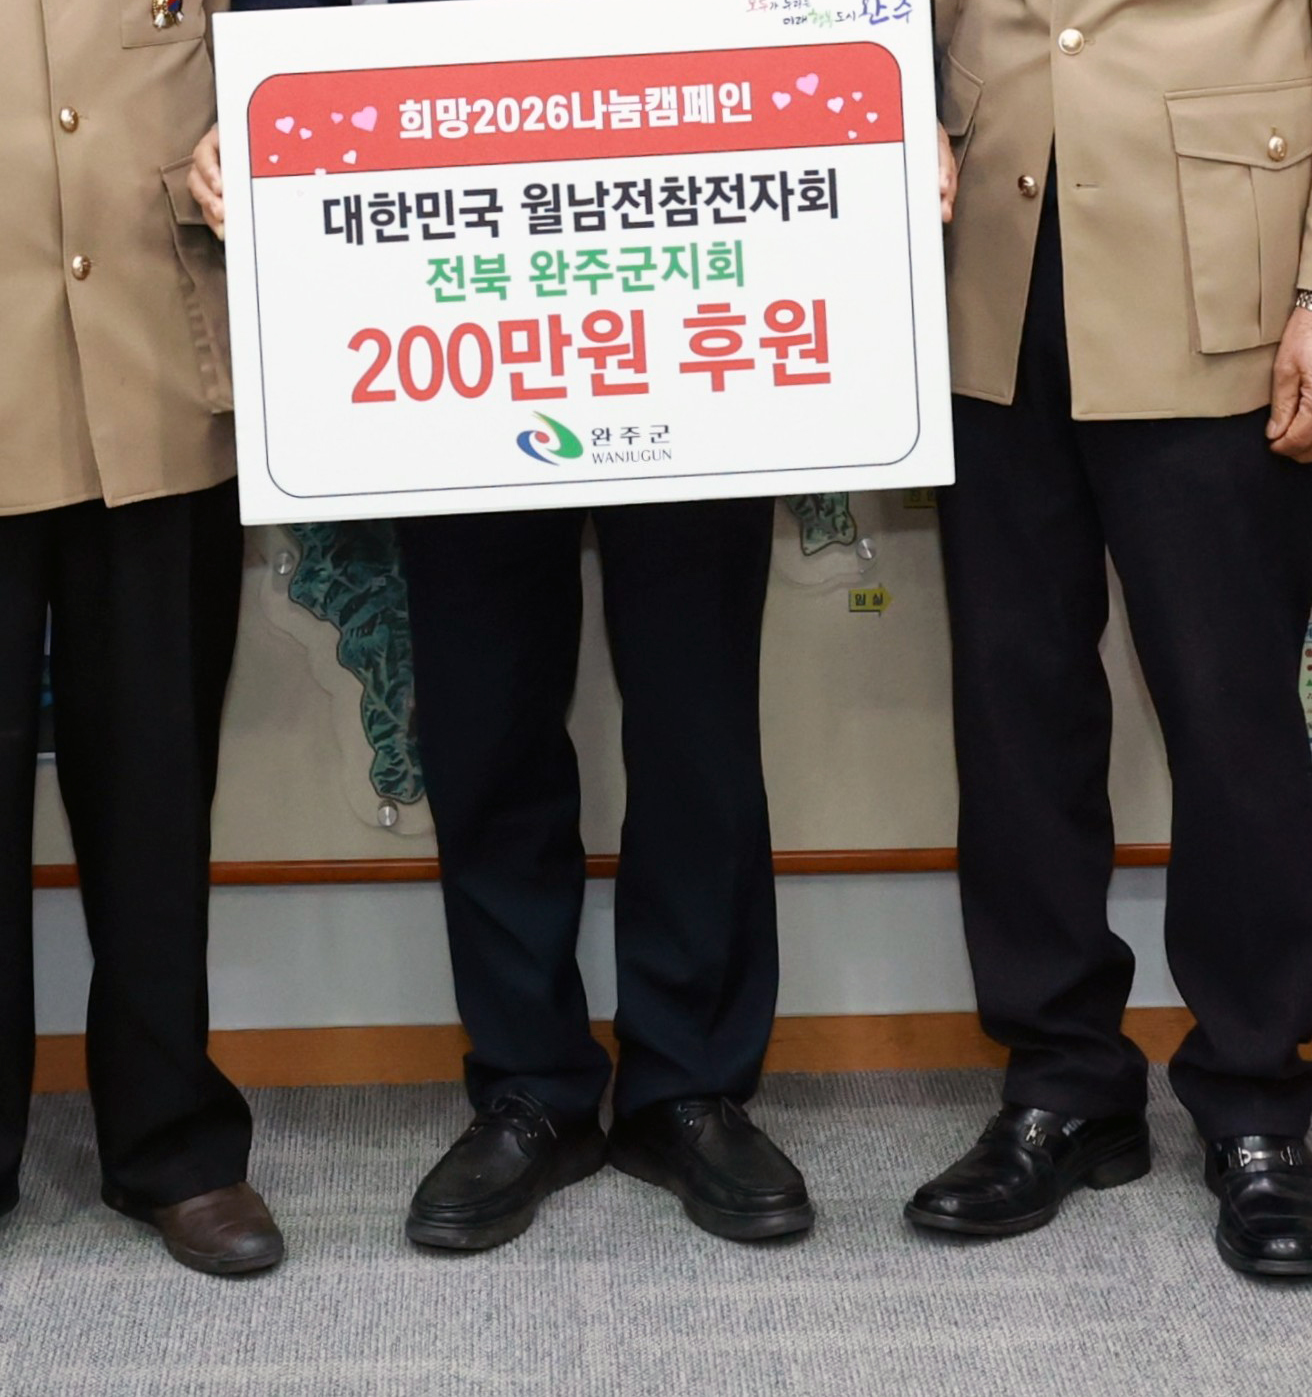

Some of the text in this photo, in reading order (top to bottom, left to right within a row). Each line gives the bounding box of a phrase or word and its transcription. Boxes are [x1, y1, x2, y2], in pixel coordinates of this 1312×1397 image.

[399, 82, 753, 139] 희망2026나눔캠페인
[323, 168, 838, 246] 대한민국 월남전참전자회
[426, 240, 744, 303] 전북 완주군지회
[348, 299, 831, 403] 200만원 후원
[591, 425, 669, 446] 완주군
[592, 446, 671, 464] WANJUGUN
